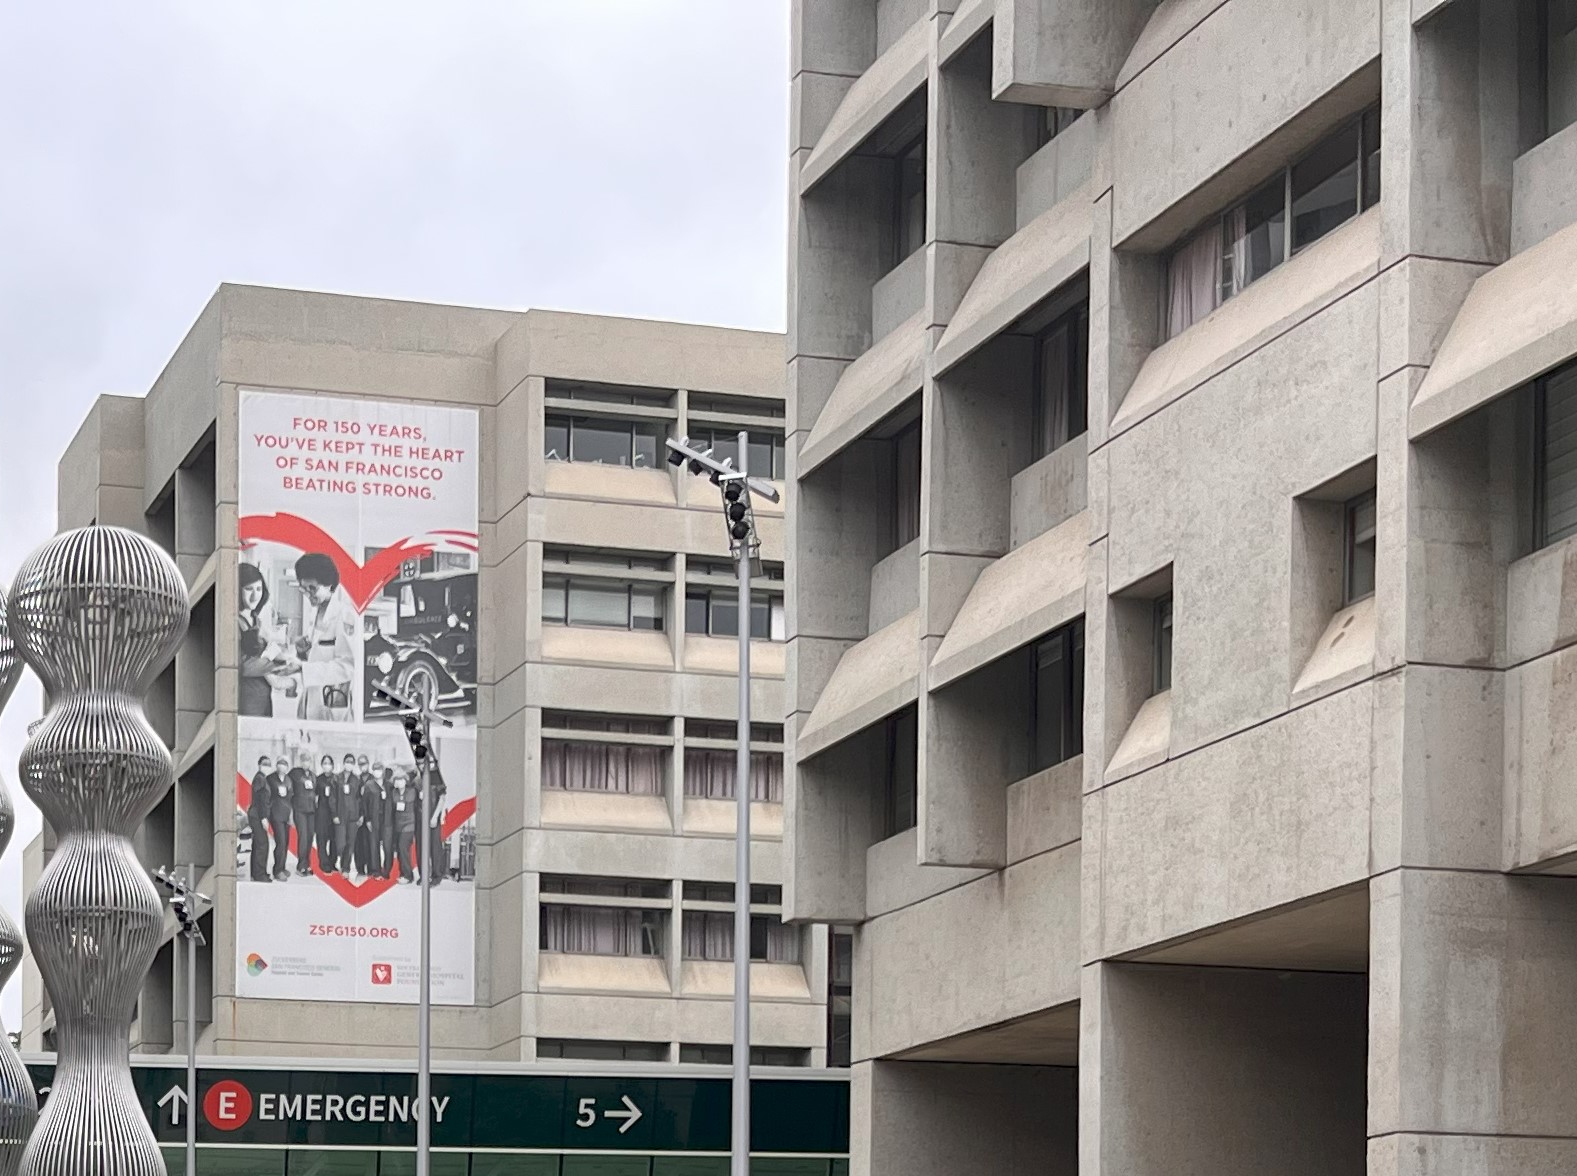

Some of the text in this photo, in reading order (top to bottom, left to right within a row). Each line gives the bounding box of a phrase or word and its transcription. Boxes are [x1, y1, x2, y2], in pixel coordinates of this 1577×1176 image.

[293, 417, 427, 442] FOR 150 YEARS,
[253, 434, 465, 463] YOU'VE KEPT THE HEART
[275, 456, 443, 481] OF SAN FRANCISCO
[283, 476, 437, 501] BEATING STRONG.
[309, 924, 399, 939] ZSFG150.ORG
[218, 1092, 237, 1120] E
[576, 1098, 596, 1127] 5
